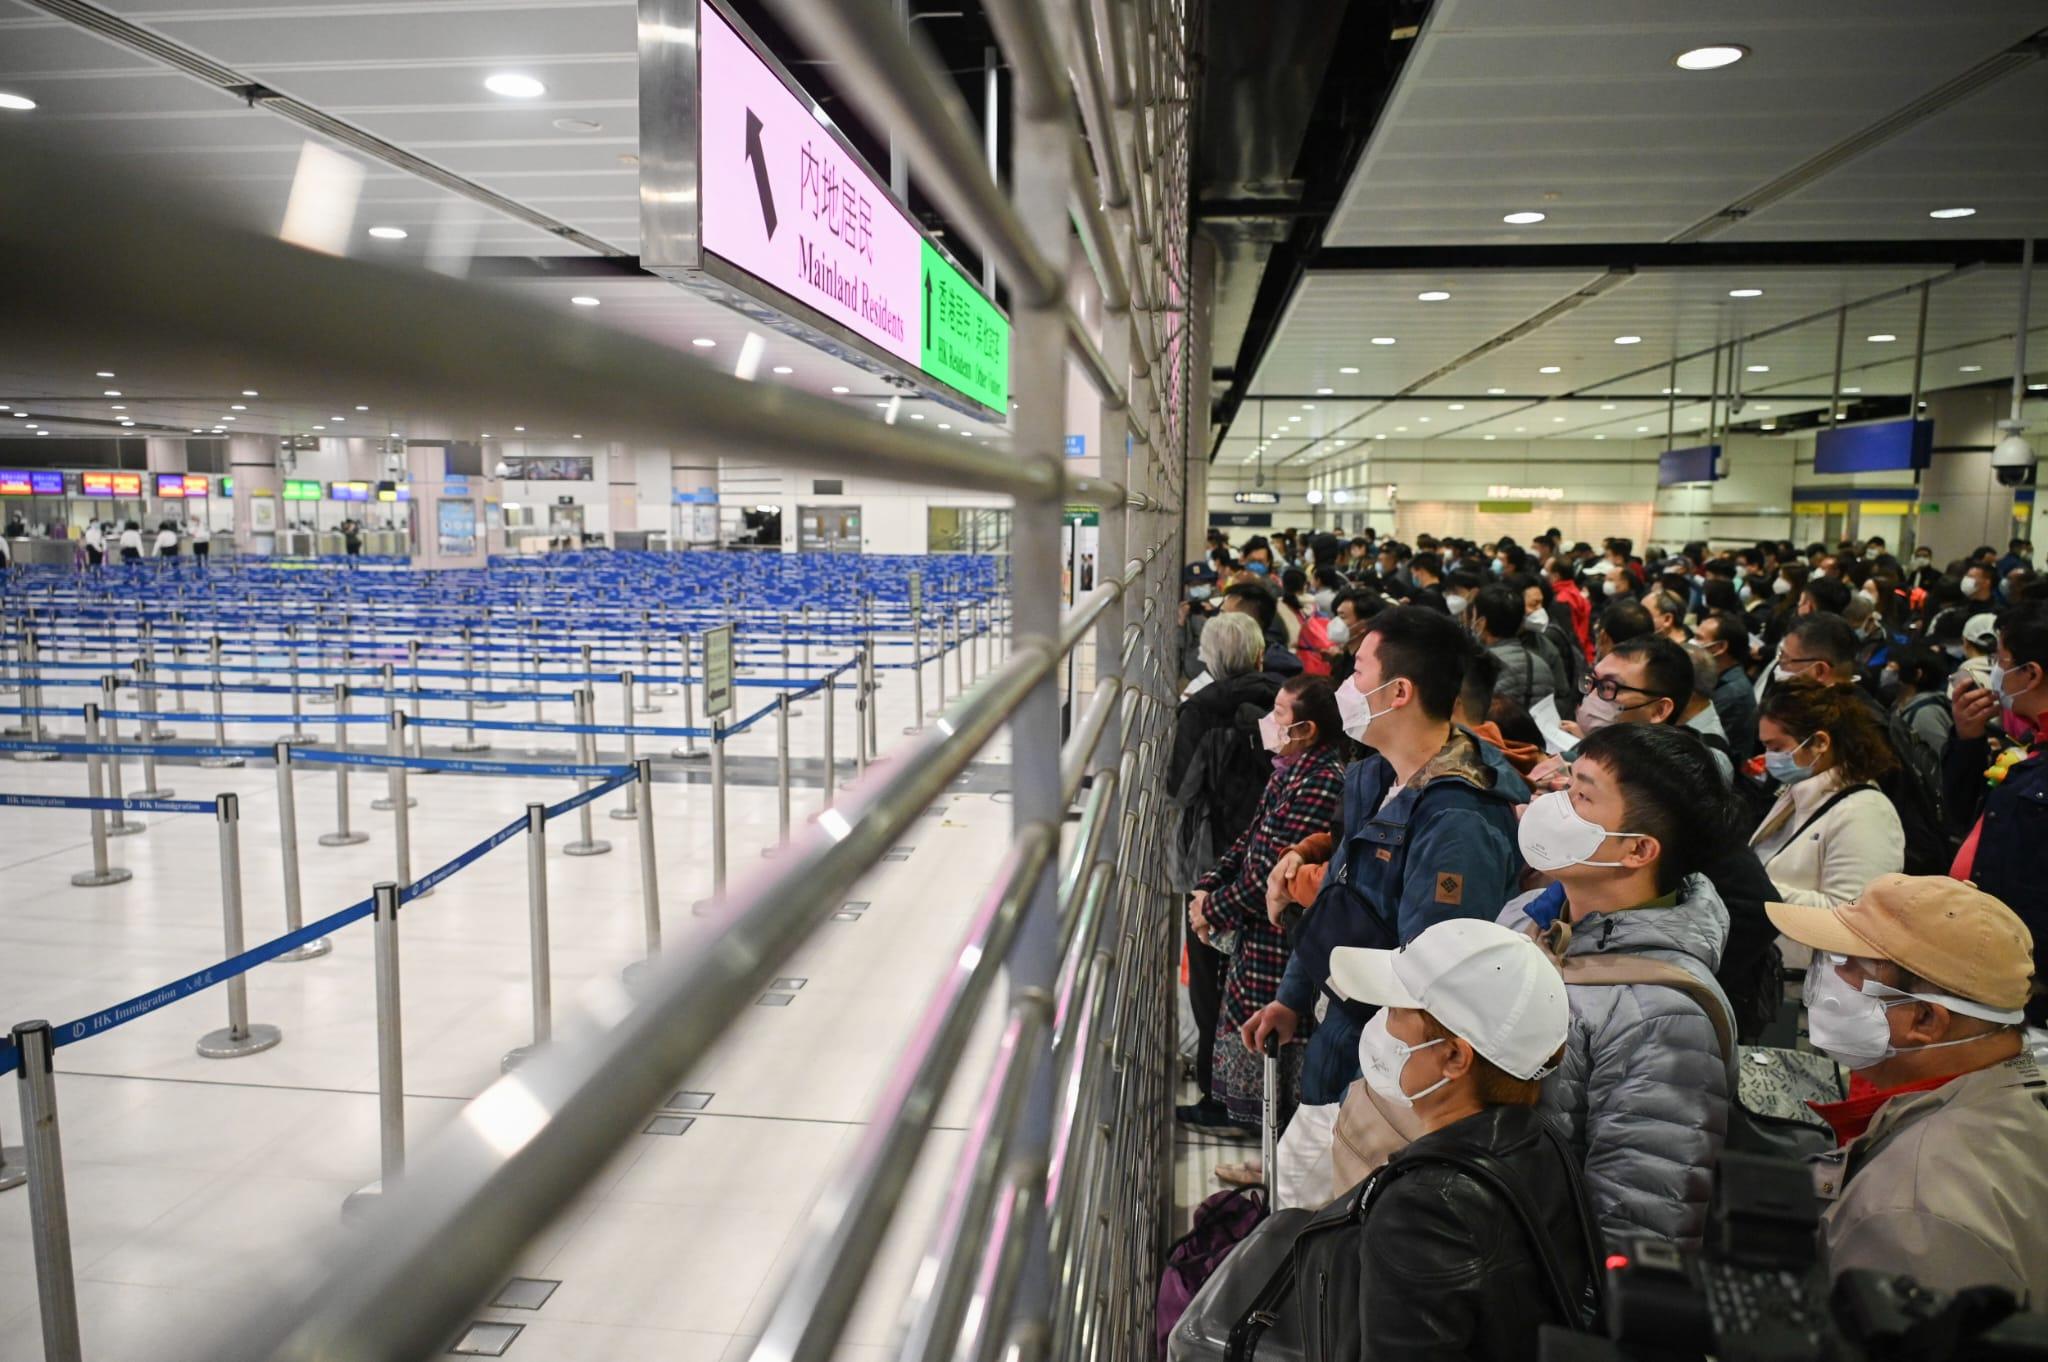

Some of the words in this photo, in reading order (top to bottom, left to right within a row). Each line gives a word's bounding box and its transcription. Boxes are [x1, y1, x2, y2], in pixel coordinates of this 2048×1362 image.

[798, 233, 858, 313] Mainland
[861, 281, 905, 343] Residents
[139, 801, 152, 810] HK
[154, 802, 201, 812] Immigration
[93, 1011, 112, 1030] HK
[115, 988, 177, 1021] Immigration
